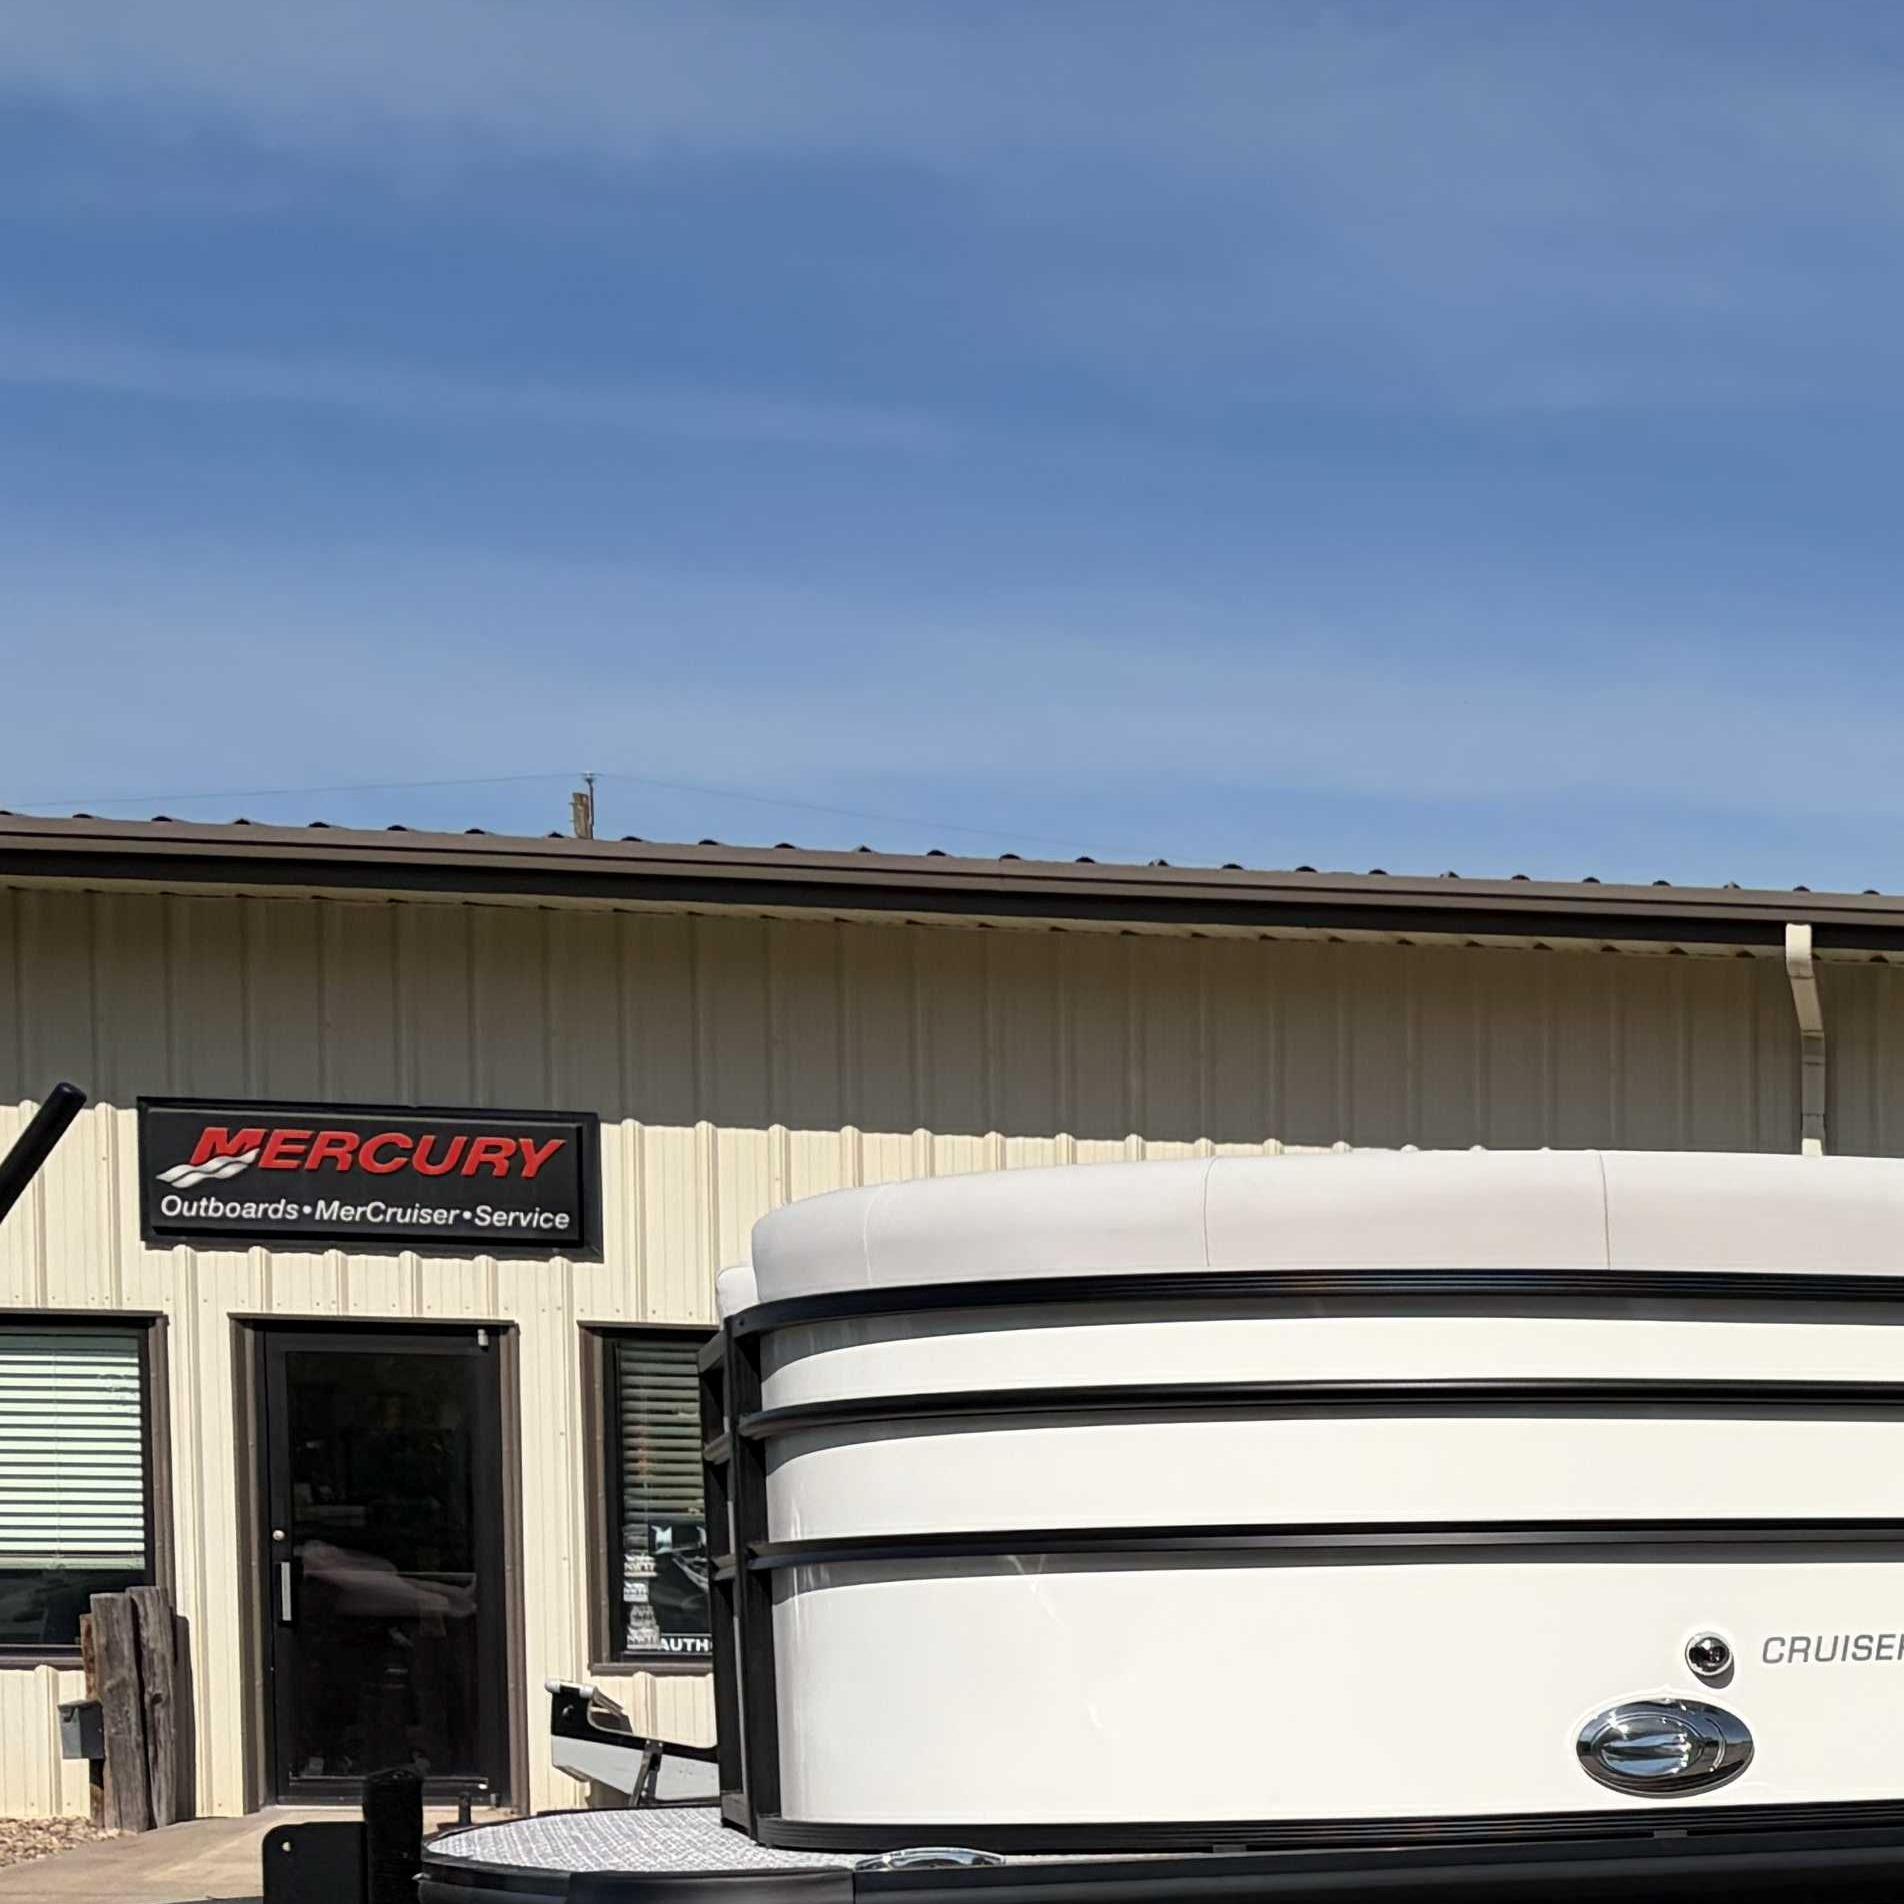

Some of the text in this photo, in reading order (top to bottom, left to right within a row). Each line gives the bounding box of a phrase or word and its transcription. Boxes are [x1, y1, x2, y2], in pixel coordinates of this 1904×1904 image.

[190, 1127, 567, 1179] MERCURY
[160, 1195, 570, 1230] Outboards MerCruiser Service
[658, 1637, 713, 1652] AUTH
